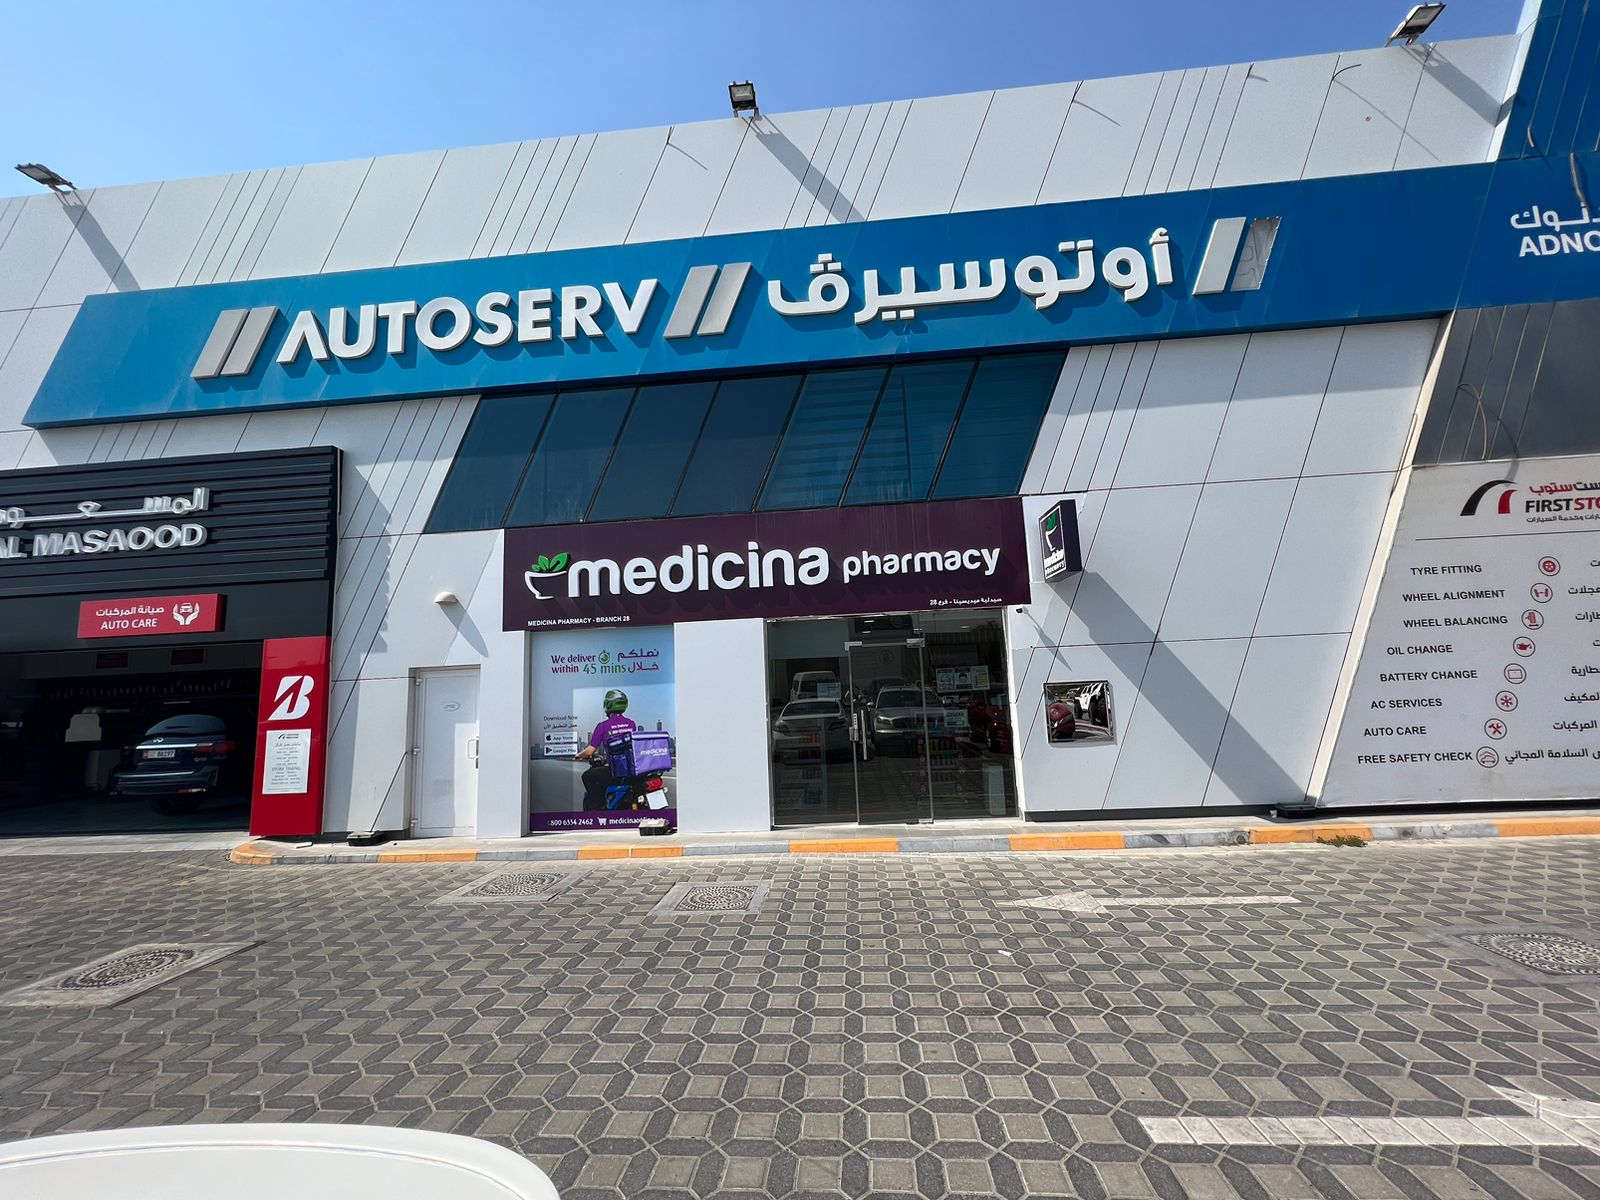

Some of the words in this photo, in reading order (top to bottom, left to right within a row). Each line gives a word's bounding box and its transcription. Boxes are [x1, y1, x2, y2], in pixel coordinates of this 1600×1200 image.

[276, 278, 660, 365] AUTOSERV
[33, 523, 208, 557] MASAOOD
[568, 541, 829, 599] medicina
[843, 547, 1000, 584] pharmacy
[1410, 566, 1439, 576] TYRE
[1442, 564, 1482, 574] FITTING
[1402, 593, 1440, 602] WHEEL
[1443, 589, 1505, 600] ALIGNMENT
[96, 606, 137, 617] المركبات
[138, 604, 165, 615] صيانة
[101, 619, 129, 630] AUTO
[131, 618, 158, 628] CARE
[527, 618, 556, 627] MEDICINA
[557, 617, 592, 625] PHARMACY
[1403, 619, 1442, 628] WHEEL
[1444, 615, 1508, 626] BALANCING
[1387, 646, 1405, 656] OIL
[1407, 644, 1453, 654] CHANGE
[550, 655, 565, 664] We
[567, 654, 596, 662] deliver
[551, 664, 579, 674] within
[583, 664, 597, 674] 45
[600, 663, 626, 674] mins
[1571, 665, 1600, 676] طارية
[1380, 672, 1428, 682] BATTERY
[1431, 670, 1478, 680] CHANGE
[1371, 700, 1386, 709] AC
[1389, 698, 1442, 708] SERVICES
[1364, 727, 1394, 737] AUTO
[1396, 726, 1427, 735] CARE
[1552, 719, 1597, 732] المركبات
[1358, 754, 1386, 764] FREE
[1389, 753, 1431, 763] SAFETY
[1434, 751, 1473, 761] CHECK
[1505, 749, 1544, 765] المجاني
[1547, 748, 1588, 758] السلامة
[578, 818, 593, 826] 2462
